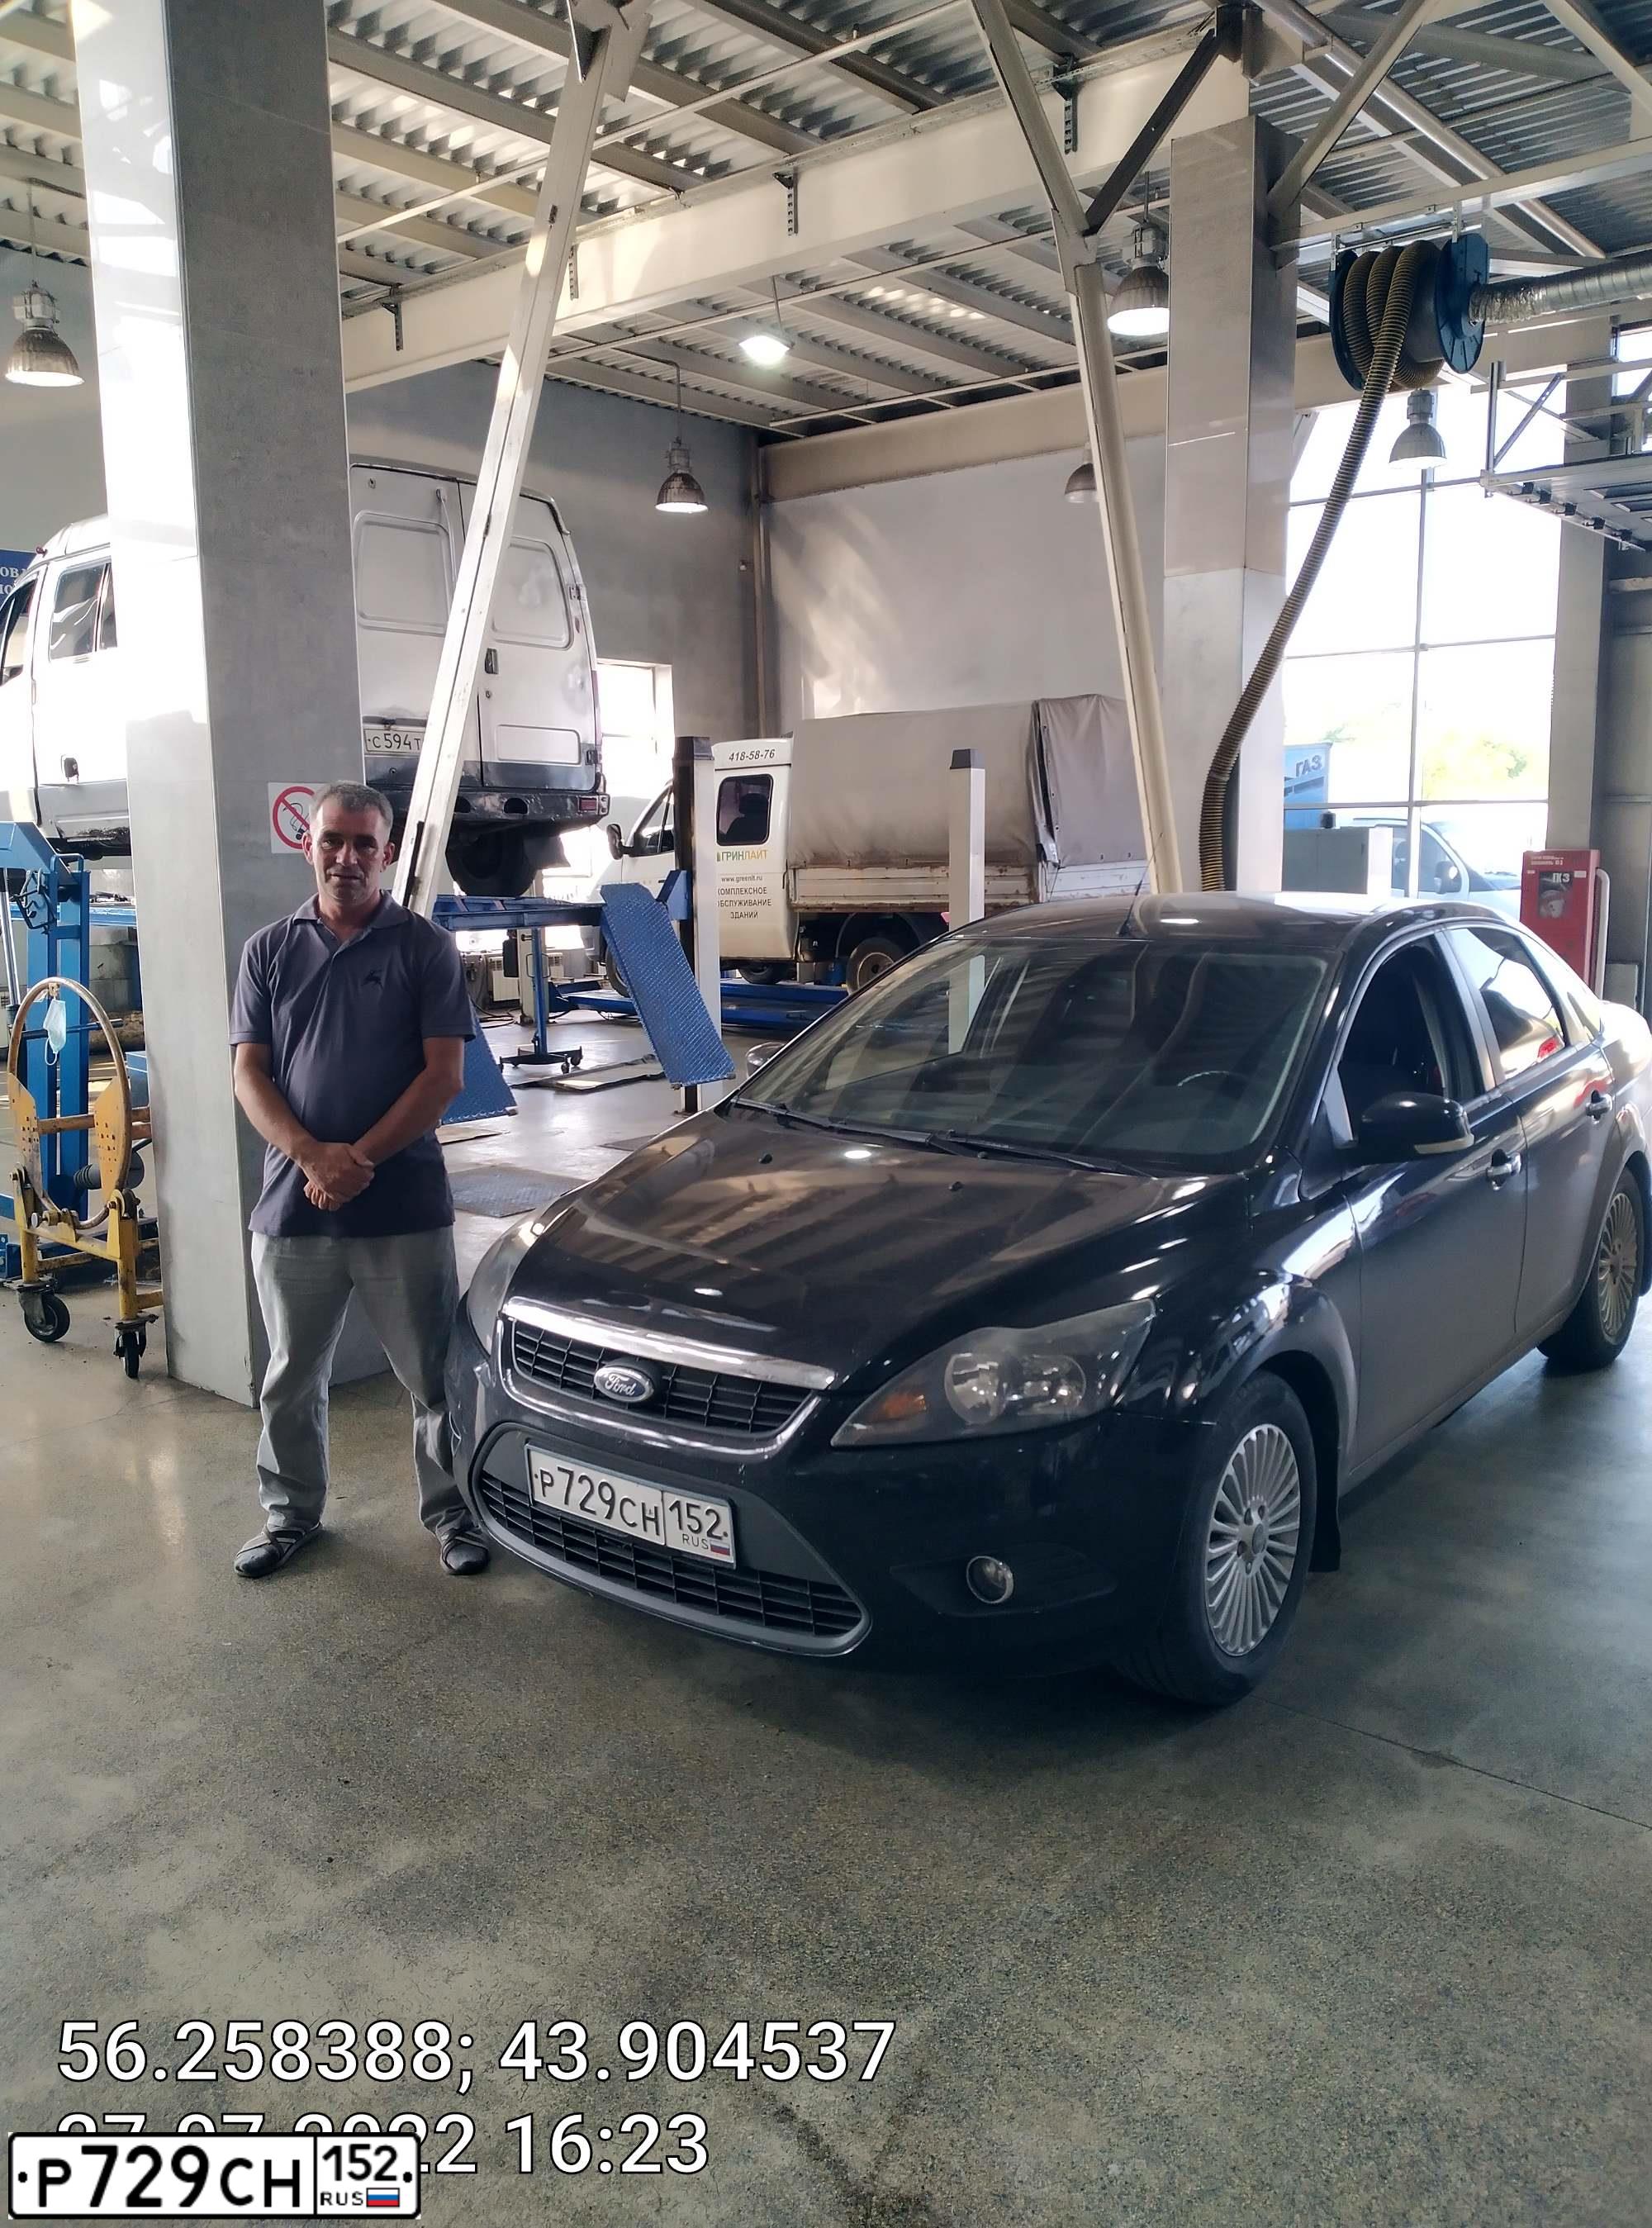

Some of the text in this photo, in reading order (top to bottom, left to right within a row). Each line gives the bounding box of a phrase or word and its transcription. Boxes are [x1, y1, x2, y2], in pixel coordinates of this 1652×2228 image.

[372, 733, 421, 750] С594Т
[728, 748, 776, 762] 418-58-76
[1295, 754, 1322, 777] ГАЗ
[604, 1372, 638, 1396] Ford
[668, 1499, 723, 1541] 152
[681, 1533, 709, 1550] RUS
